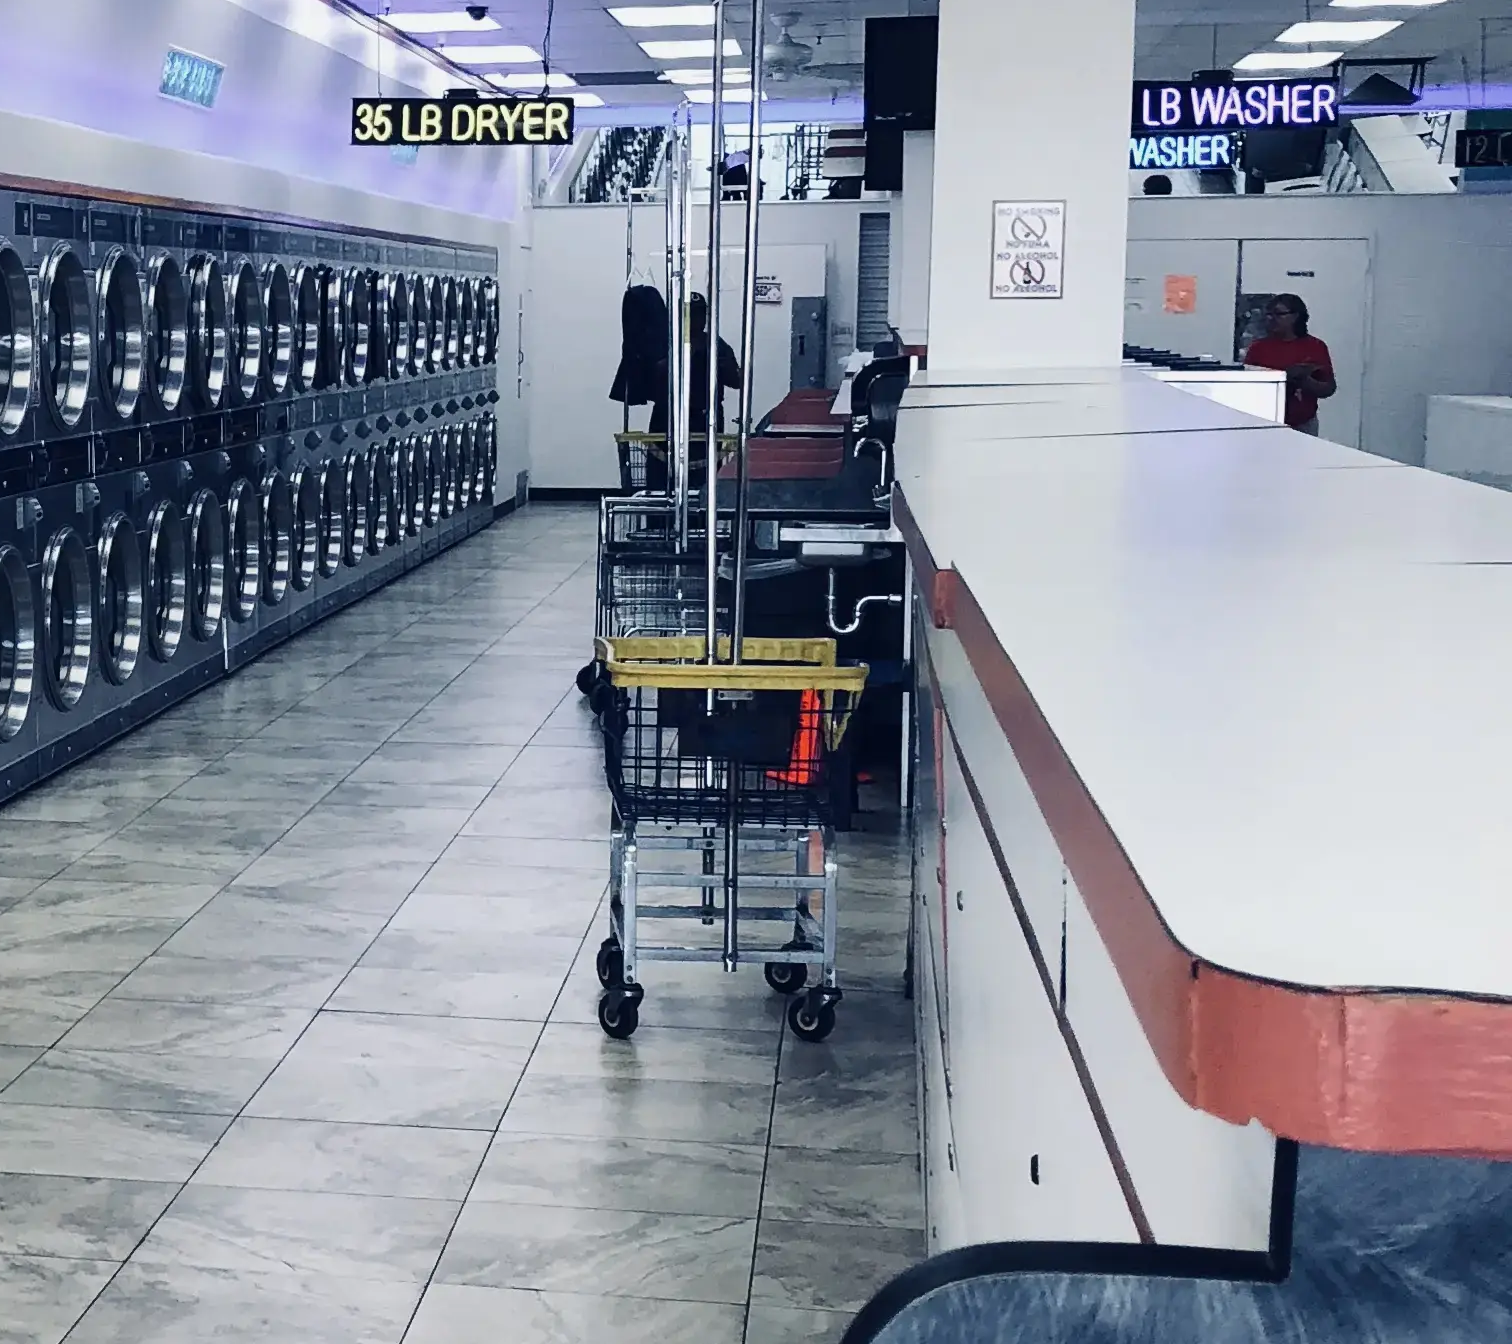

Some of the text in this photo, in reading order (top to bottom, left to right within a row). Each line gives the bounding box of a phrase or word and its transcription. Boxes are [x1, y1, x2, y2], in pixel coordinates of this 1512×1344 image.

[354, 102, 569, 142] 35 LB DRYER
[1142, 84, 1337, 126] LB WASHER
